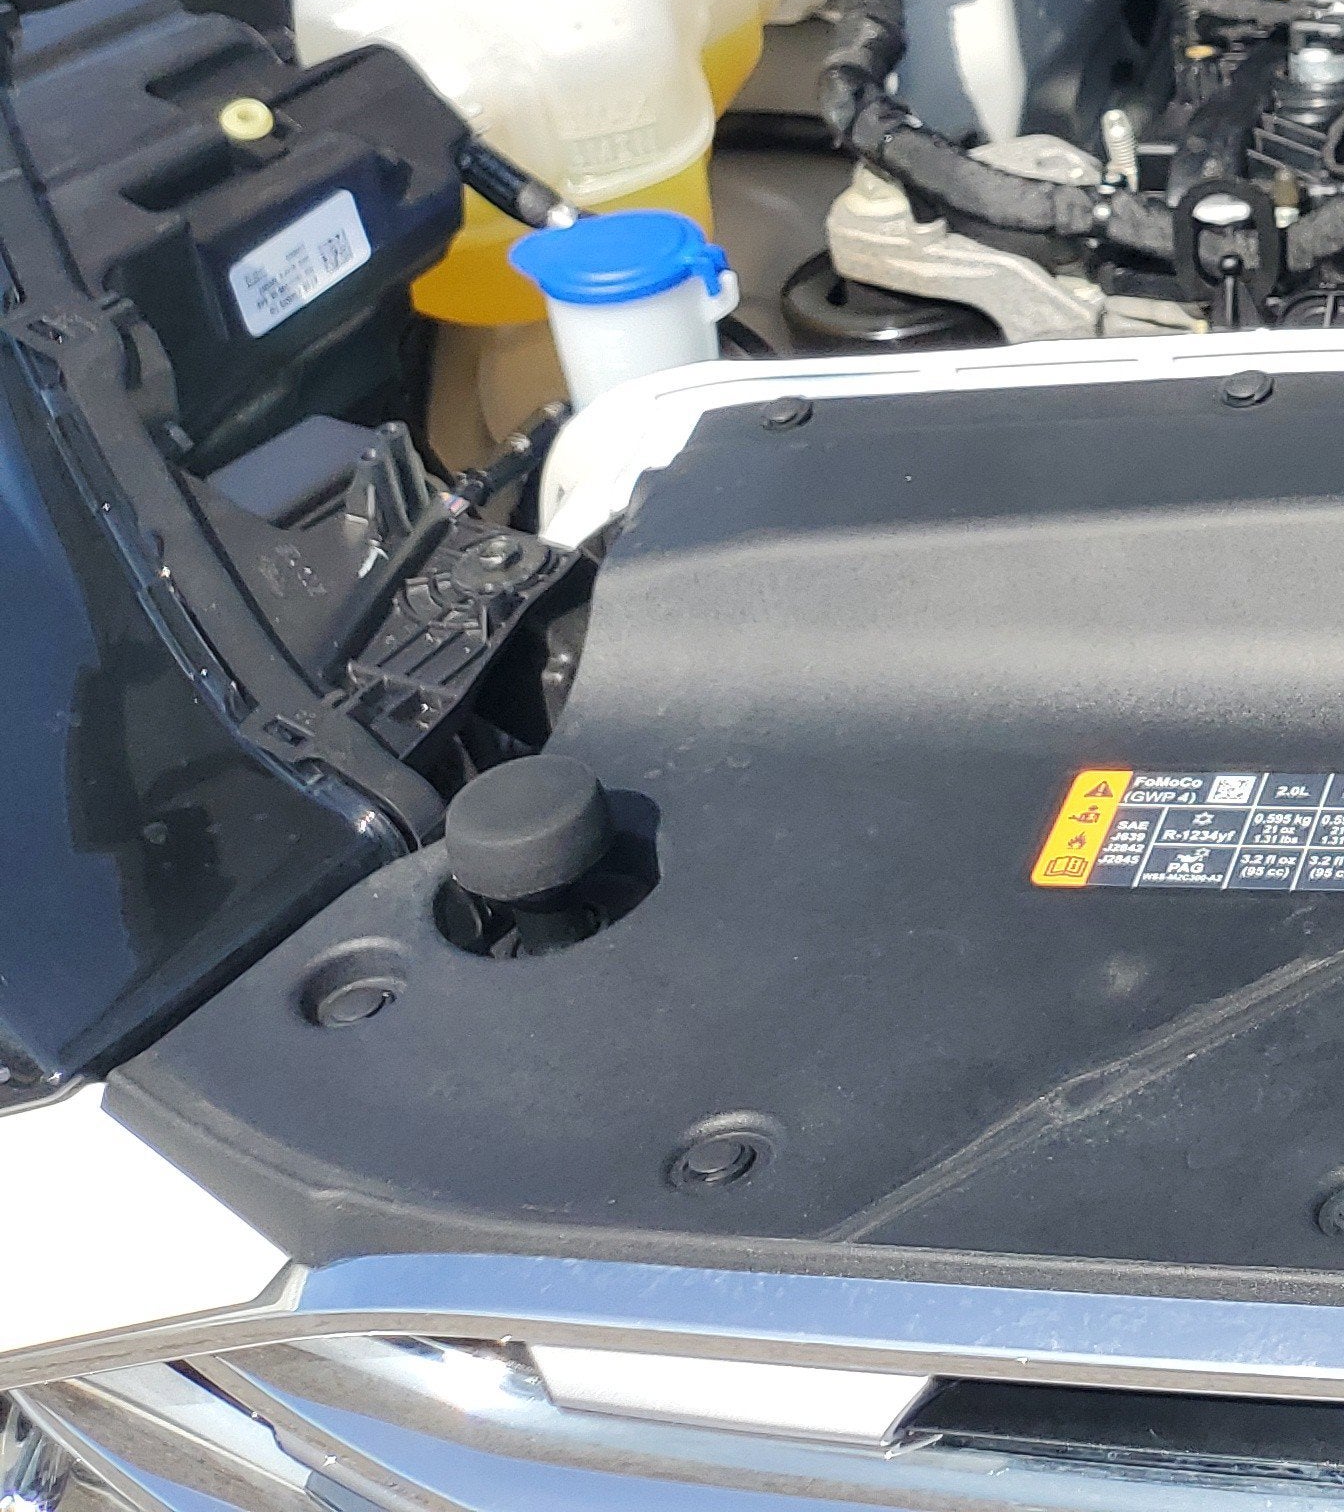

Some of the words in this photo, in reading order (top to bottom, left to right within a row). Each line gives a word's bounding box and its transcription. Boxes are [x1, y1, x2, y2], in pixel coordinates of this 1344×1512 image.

[1133, 776, 1203, 788] FoMoCo
[1123, 791, 1175, 804] (GWP
[1176, 792, 1197, 804] 4)
[1275, 786, 1310, 798] 2.0L
[1117, 820, 1149, 831] SAE
[1253, 813, 1292, 825] 0.595
[1293, 814, 1312, 828] kg
[1261, 825, 1278, 835] 21
[1279, 827, 1296, 835] oz
[1329, 826, 1344, 836] 21
[1162, 829, 1236, 844] R-1234yf
[1253, 834, 1279, 844] 1.31
[1279, 835, 1298, 845] lbs
[1240, 854, 1263, 865] 3.2
[1265, 854, 1276, 865] fl
[1278, 856, 1297, 865] oz
[1309, 855, 1332, 866] 3.2
[1333, 855, 1344, 866] fl
[1166, 863, 1205, 874] PAG
[1241, 866, 1265, 878] (95
[1267, 867, 1290, 880] cc)
[1309, 867, 1333, 879] (95
